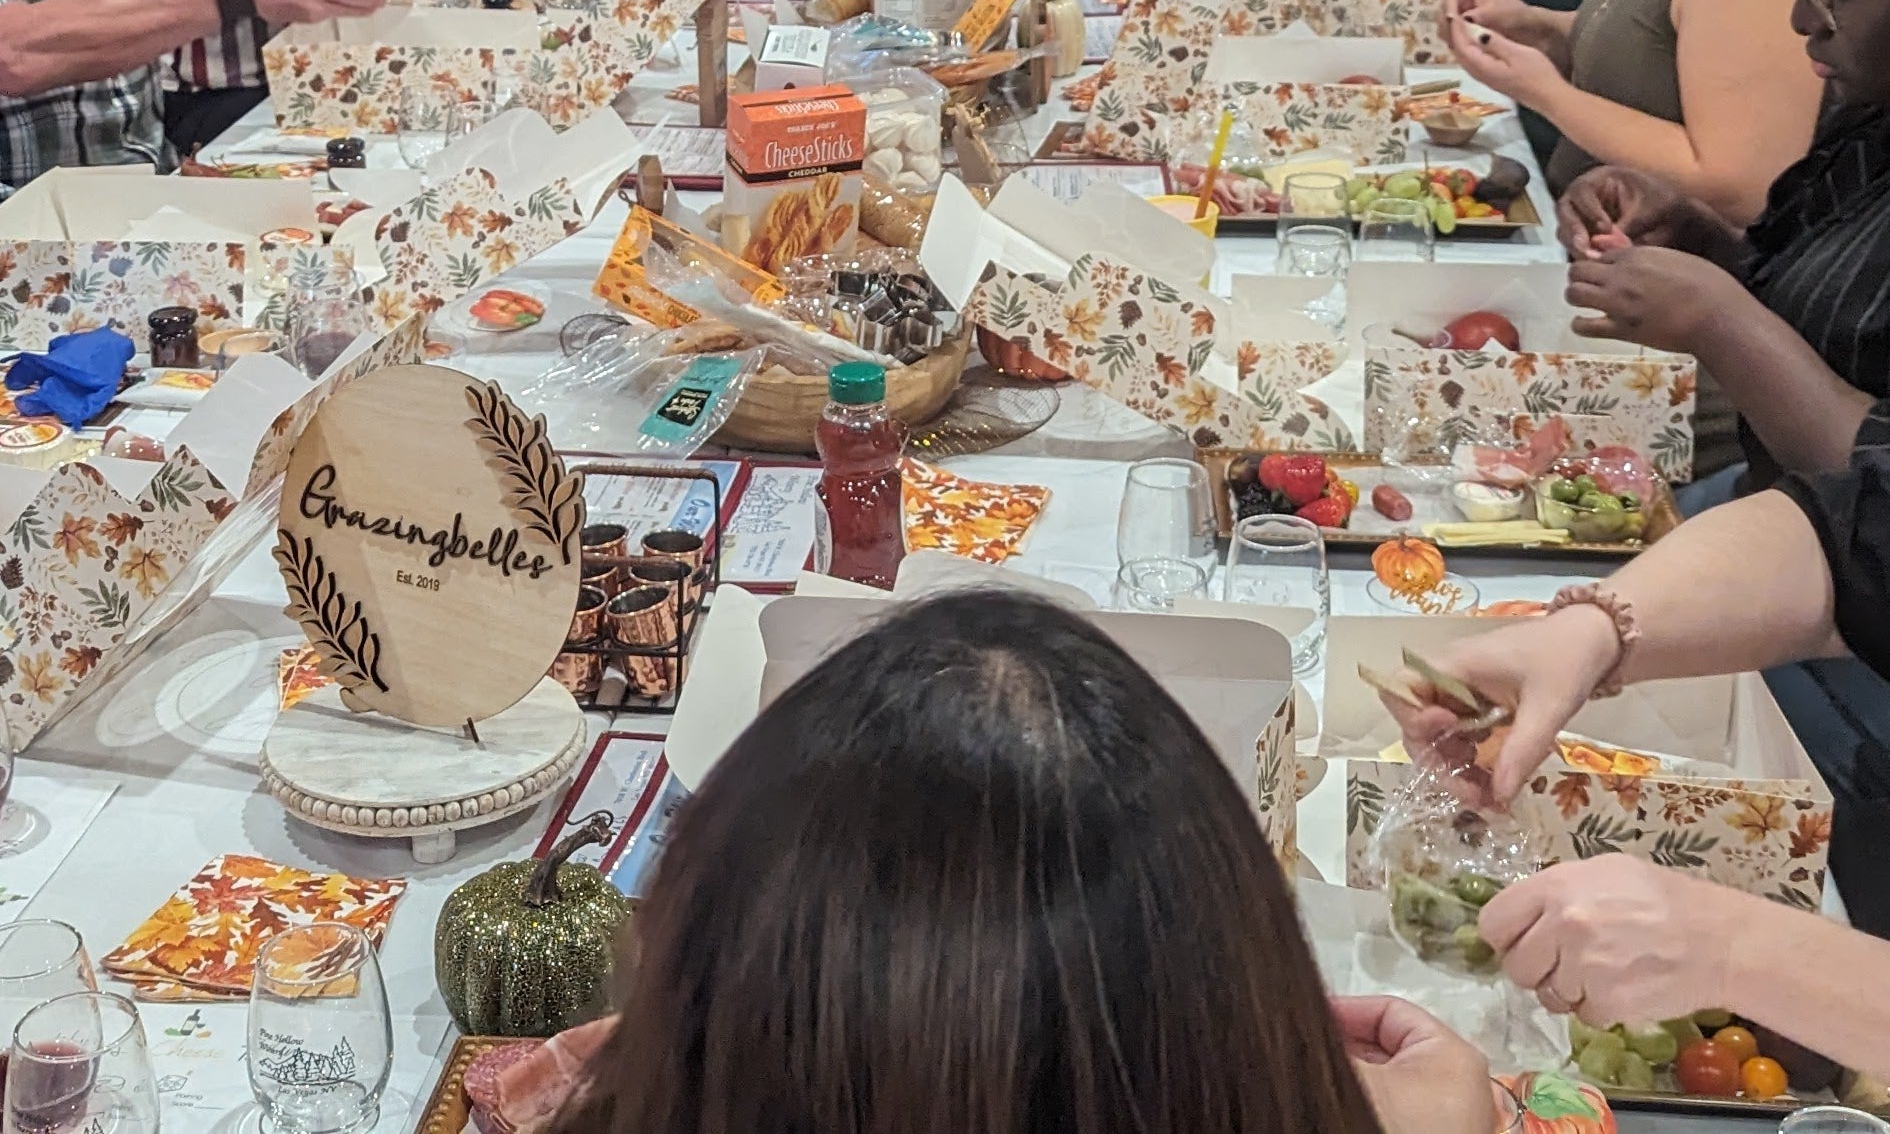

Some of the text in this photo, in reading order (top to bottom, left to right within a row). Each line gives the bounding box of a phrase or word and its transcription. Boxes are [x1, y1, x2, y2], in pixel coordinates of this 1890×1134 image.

[764, 133, 853, 168] CheeseSticks
[787, 166, 829, 178] CHEDDAR
[299, 464, 554, 580] Grazingbelles
[396, 570, 441, 592] Est. 2019
